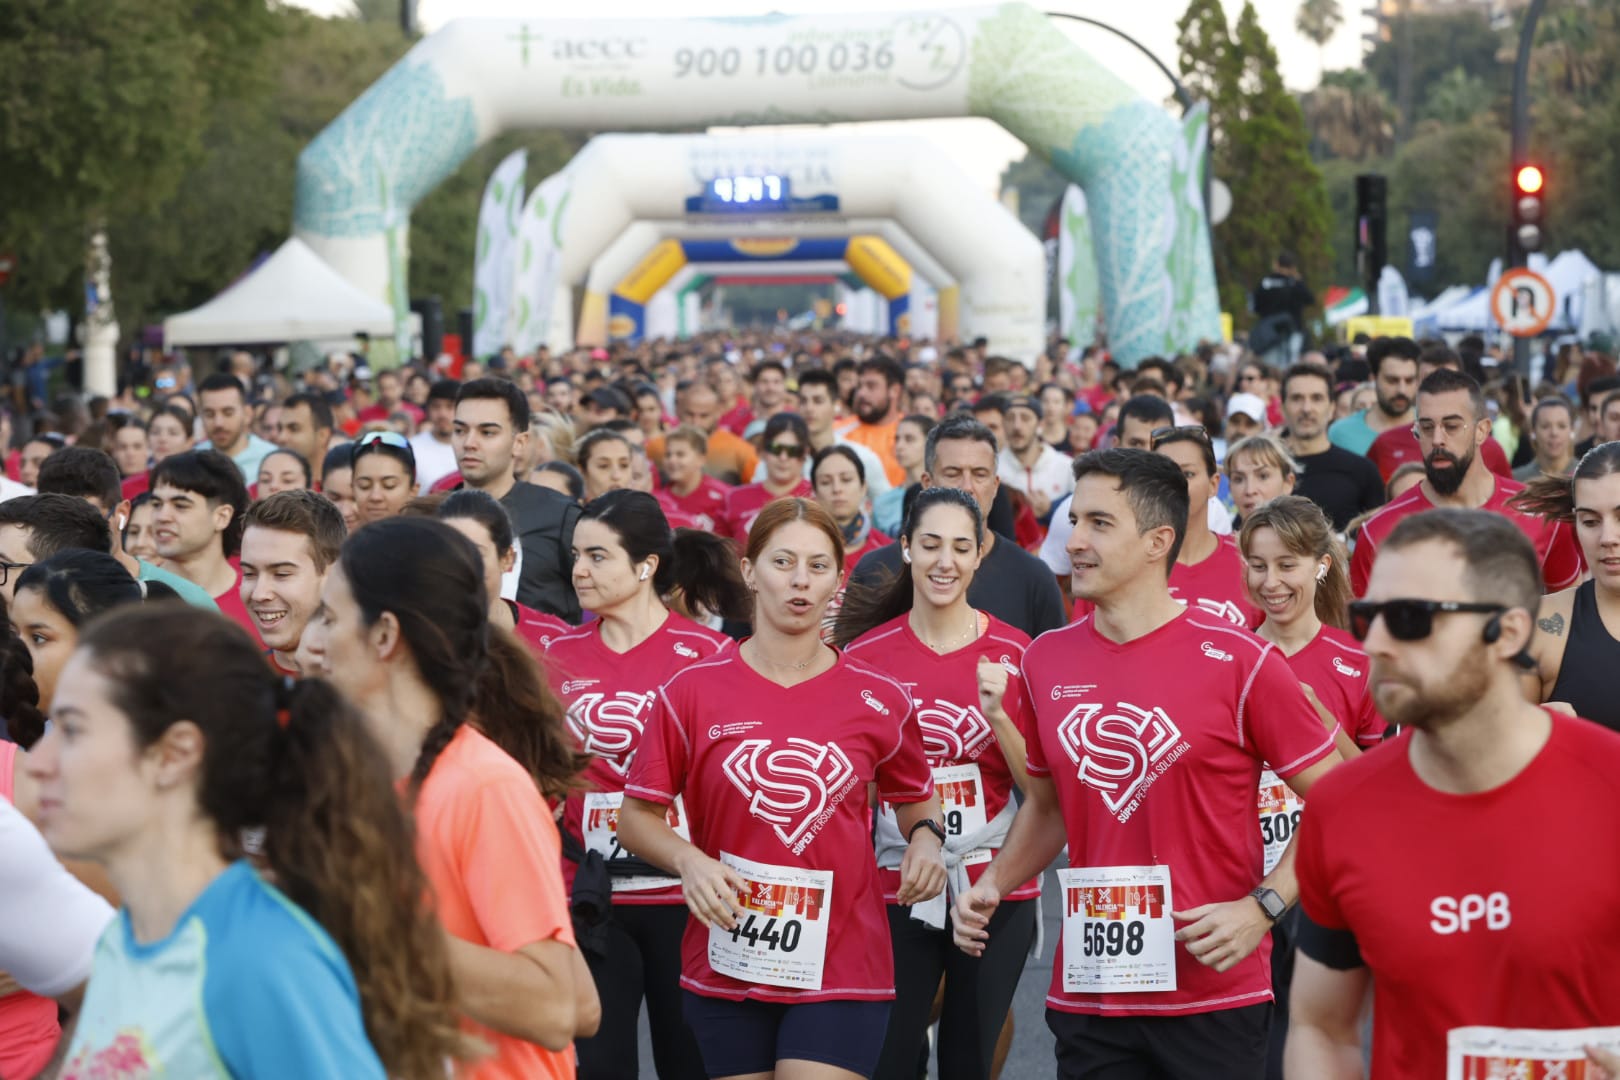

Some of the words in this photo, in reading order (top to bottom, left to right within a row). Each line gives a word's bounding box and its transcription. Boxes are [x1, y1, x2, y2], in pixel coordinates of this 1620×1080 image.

[552, 37, 648, 60] aecc
[673, 46, 742, 79] 900
[756, 44, 819, 77] 100
[827, 40, 895, 73] 036
[1155, 740, 1192, 775] SOLIDARIA
[1430, 891, 1512, 935] SPB
[1083, 920, 1145, 957] 5698
